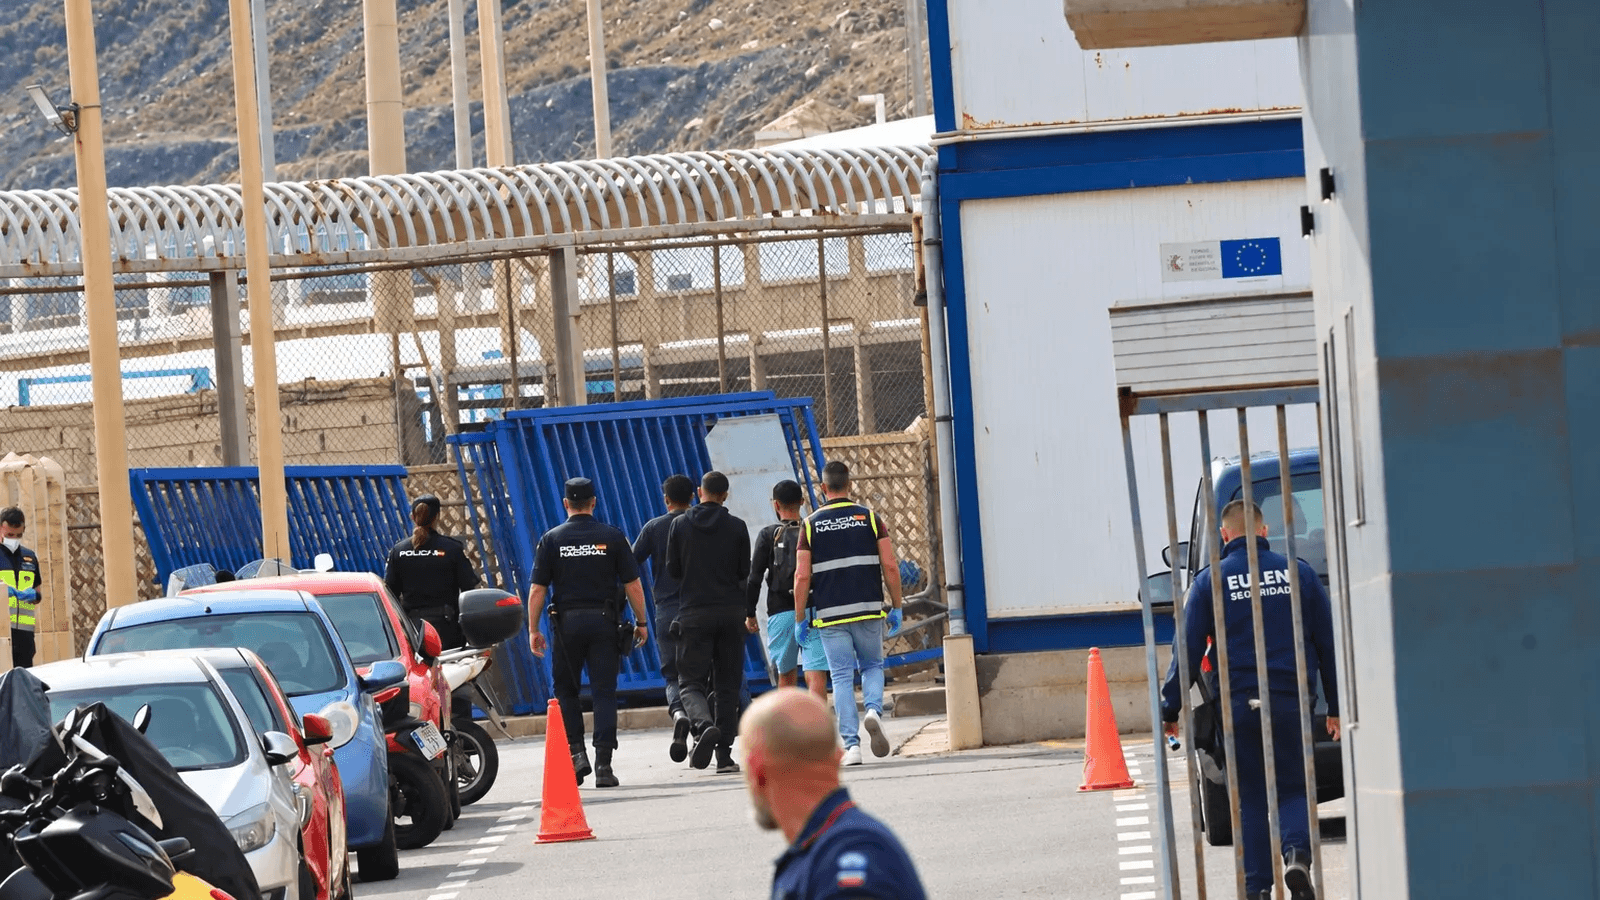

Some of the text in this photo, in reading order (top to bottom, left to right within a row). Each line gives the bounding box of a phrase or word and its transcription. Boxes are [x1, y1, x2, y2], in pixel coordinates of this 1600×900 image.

[815, 515, 856, 527] POLICIA
[815, 521, 867, 533] NACIONAL
[559, 544, 598, 552] POLICIA
[559, 550, 607, 558] NACIONAL
[1230, 585, 1292, 601] SEGRIDAD
